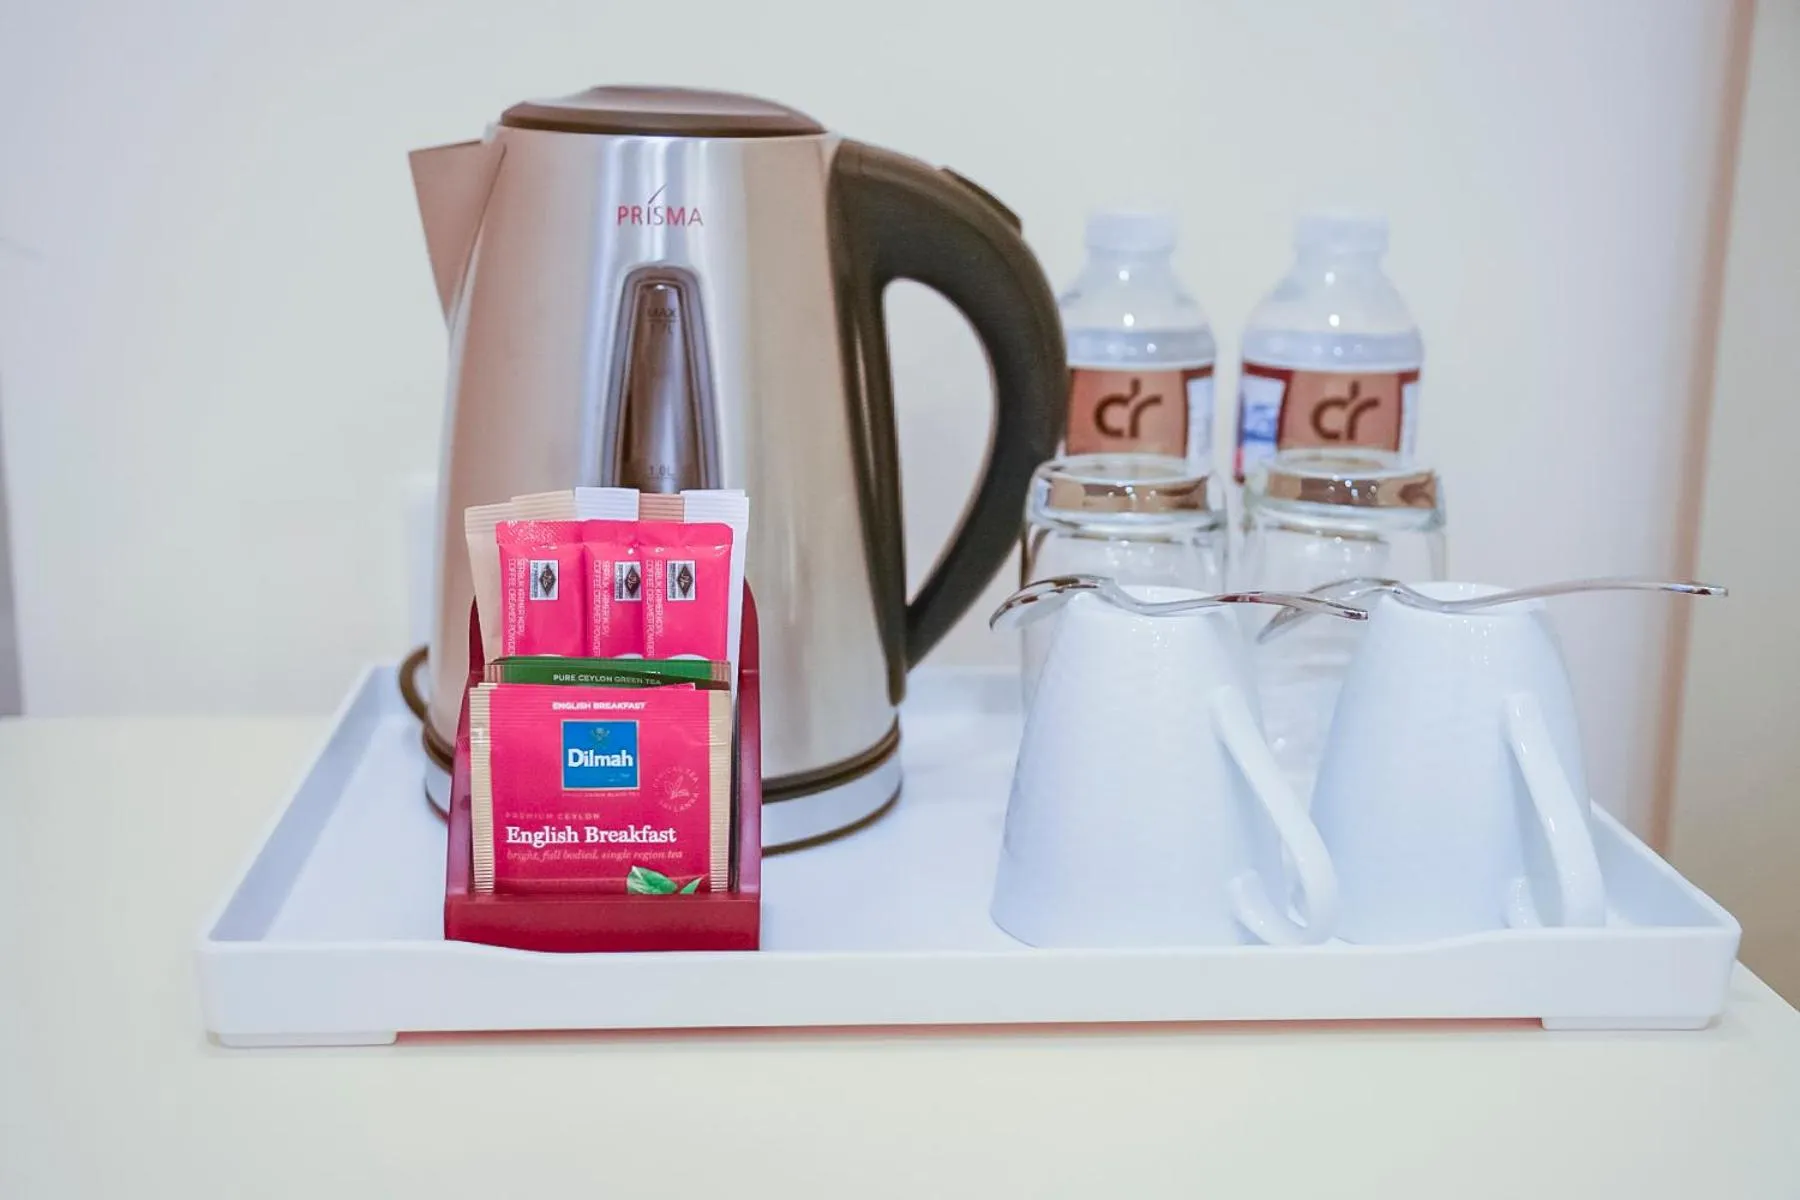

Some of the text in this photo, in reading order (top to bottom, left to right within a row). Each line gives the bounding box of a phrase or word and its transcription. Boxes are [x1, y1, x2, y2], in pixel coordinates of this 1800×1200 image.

[553, 673, 662, 685] PURE CEYLON GREEN TEA
[552, 701, 646, 710] ENGLISH BREAKFAST
[568, 748, 634, 768] Dilmah
[558, 812, 600, 820] CEYLON
[506, 825, 677, 848] English Breakfast
[540, 848, 560, 862] full
[601, 849, 631, 862] single
[633, 851, 665, 862] region
[667, 850, 683, 859] tea
